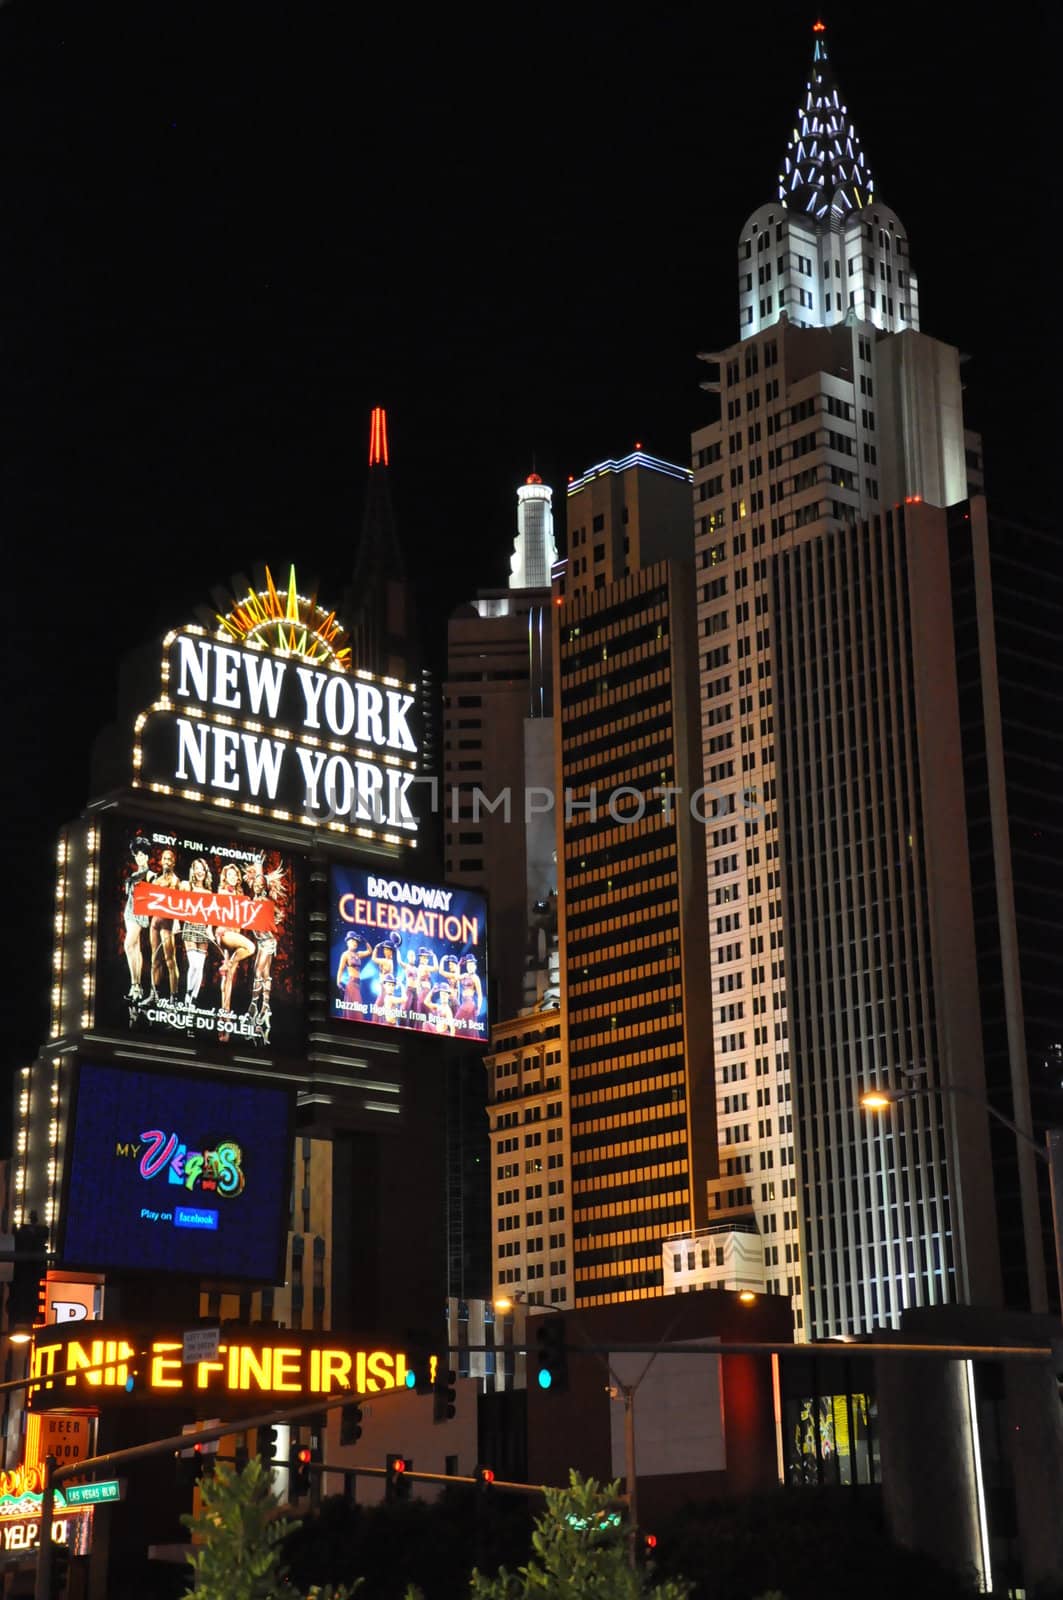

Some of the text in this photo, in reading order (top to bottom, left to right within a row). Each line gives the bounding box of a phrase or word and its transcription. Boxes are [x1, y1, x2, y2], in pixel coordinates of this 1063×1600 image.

[176, 636, 418, 753] NEW YORK
[175, 718, 418, 831] NEW YORK
[152, 833, 263, 863] SEXY FUN ACROBATIC
[367, 876, 453, 911] BROADWAY
[339, 893, 478, 945] CELEBRATION
[146, 1009, 194, 1029] CIRQUE
[196, 1017, 215, 1030] DU
[335, 998, 368, 1014] Dazzling
[409, 1010, 427, 1022] from
[469, 1020, 485, 1031] Best
[141, 1208, 214, 1225] Play on facebook
[197, 1344, 302, 1391] FINE
[49, 1420, 80, 1433] BEER
[48, 1445, 79, 1457] OOD
[69, 1485, 117, 1502] LAS VEGAS BLVD
